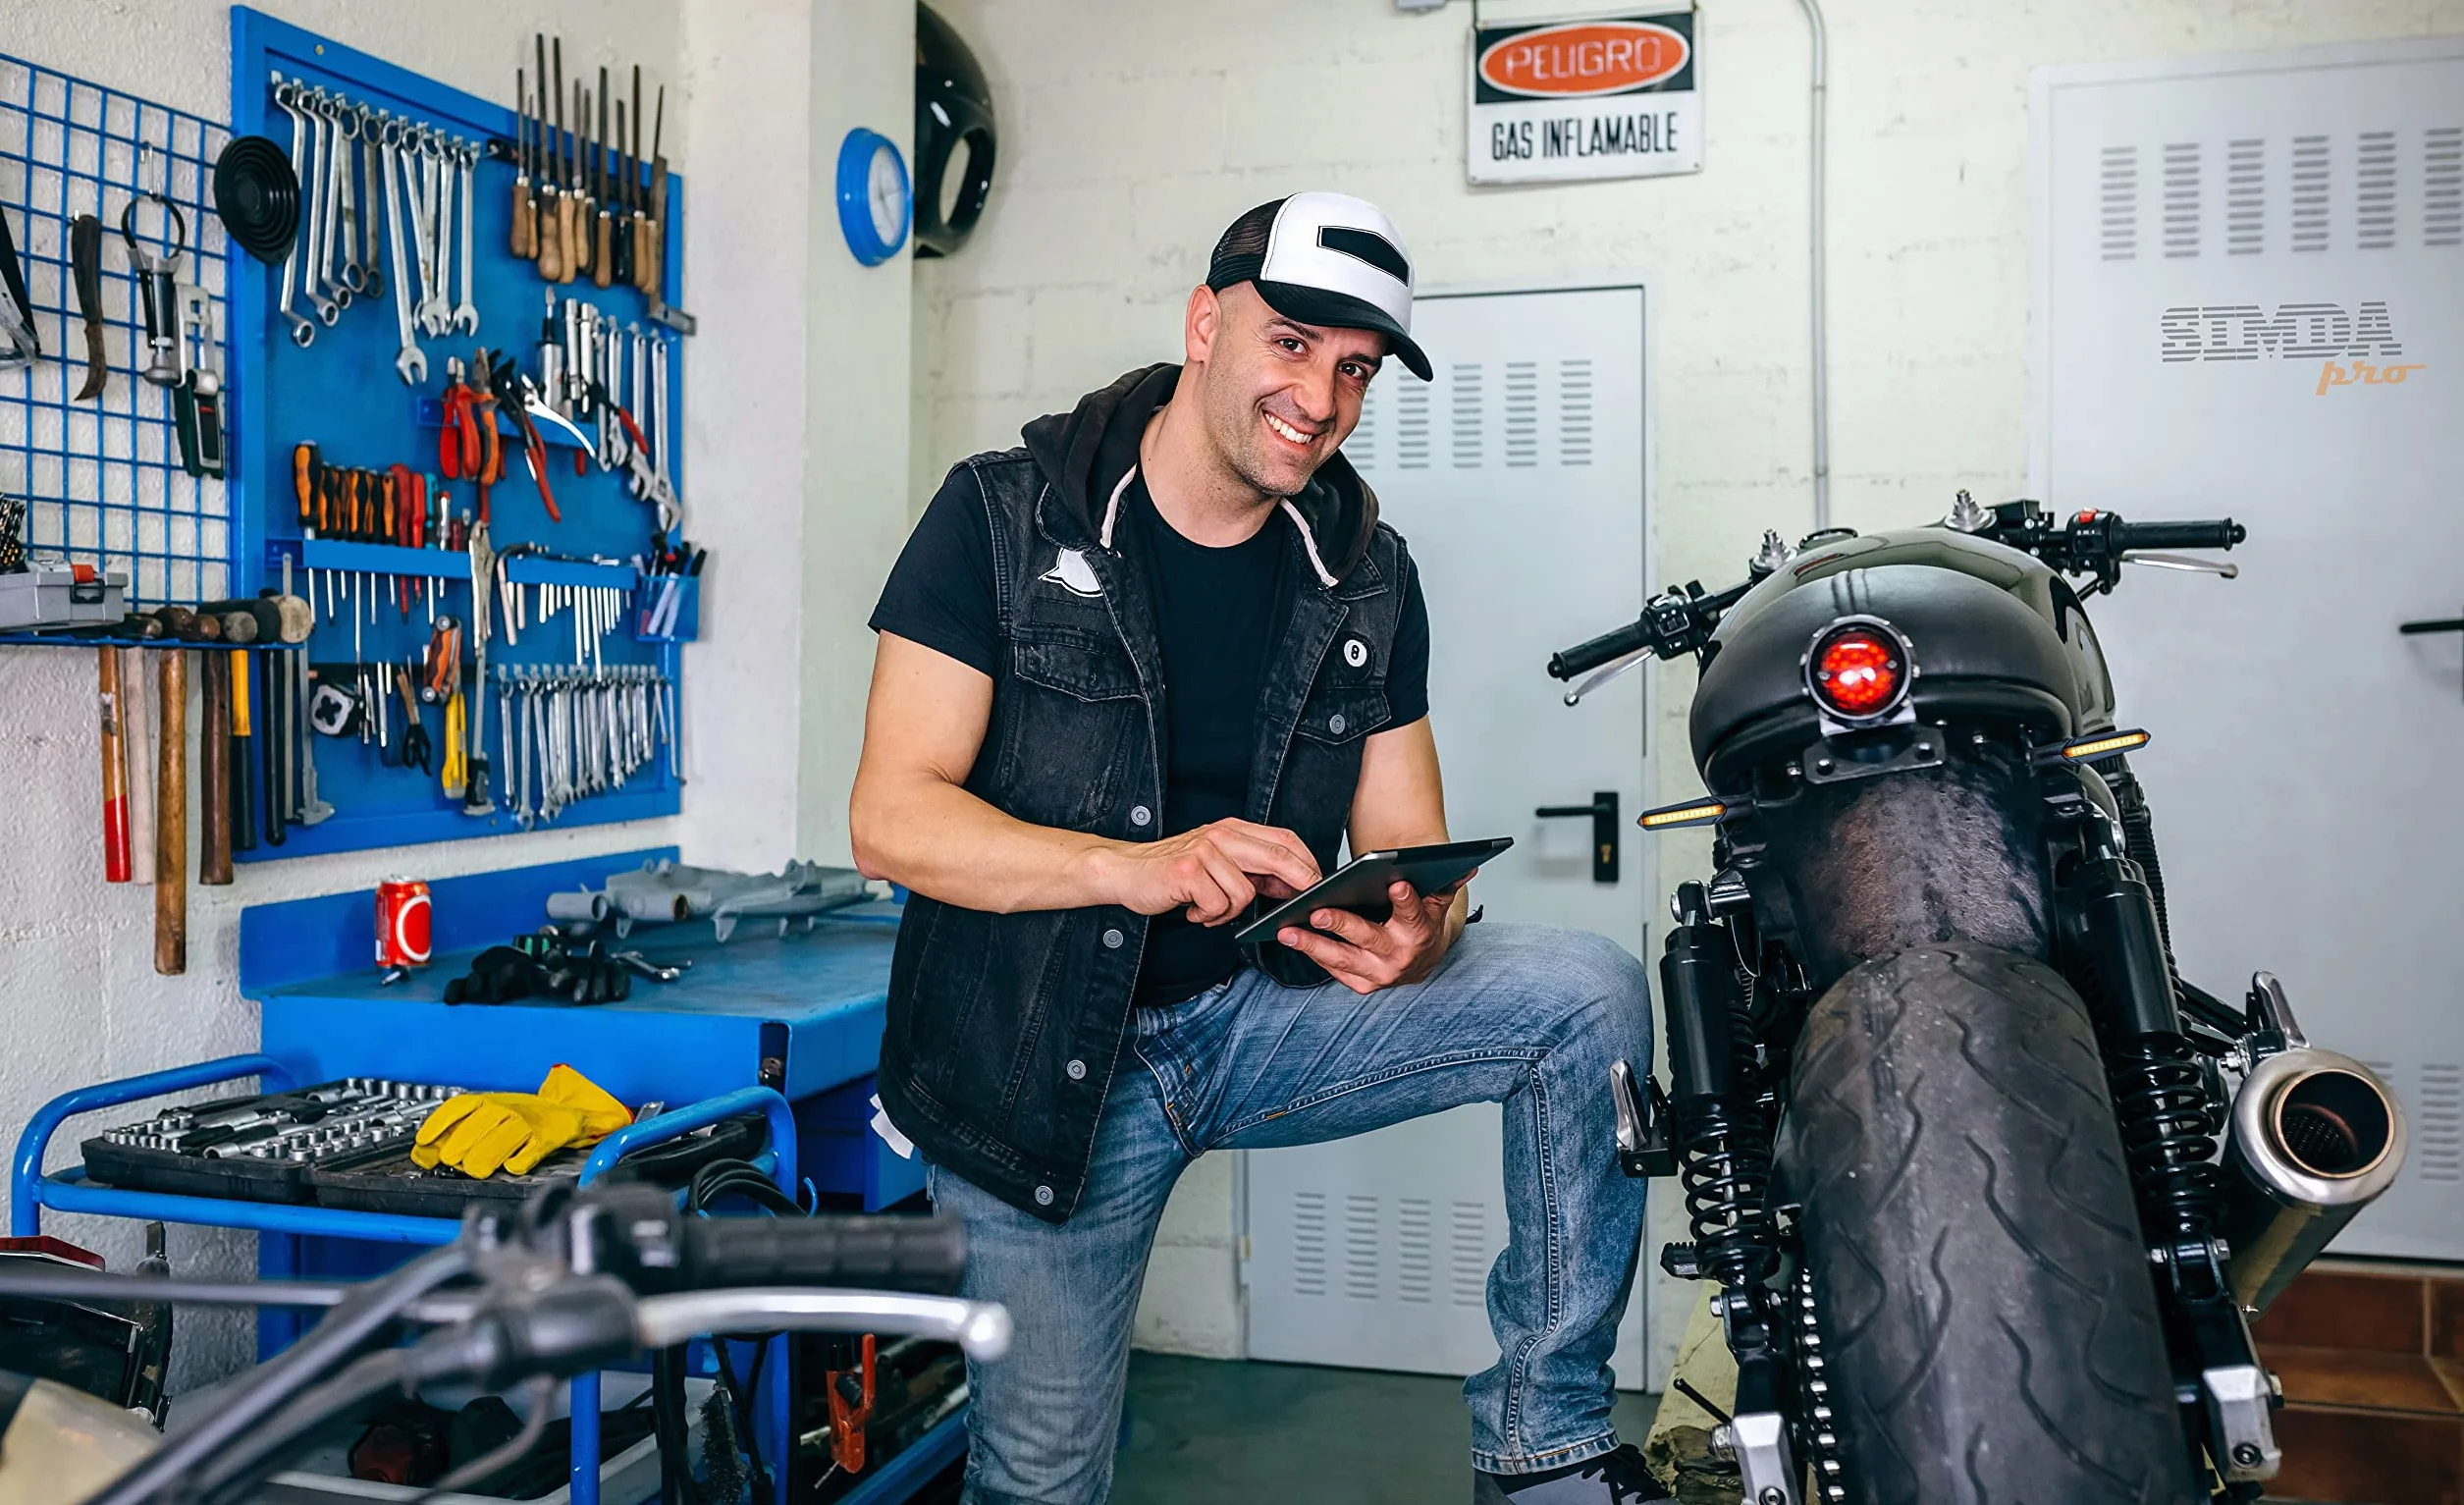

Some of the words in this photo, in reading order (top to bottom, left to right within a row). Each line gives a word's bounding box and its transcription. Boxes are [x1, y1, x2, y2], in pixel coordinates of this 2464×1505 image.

[1505, 36, 1662, 81] PELIGRO
[1491, 120, 1533, 161] GAS
[1542, 111, 1678, 159] INFLAMABLE
[2161, 301, 2402, 362] SIMDA
[2315, 359, 2427, 396] pro
[1351, 644, 1361, 661] 8
